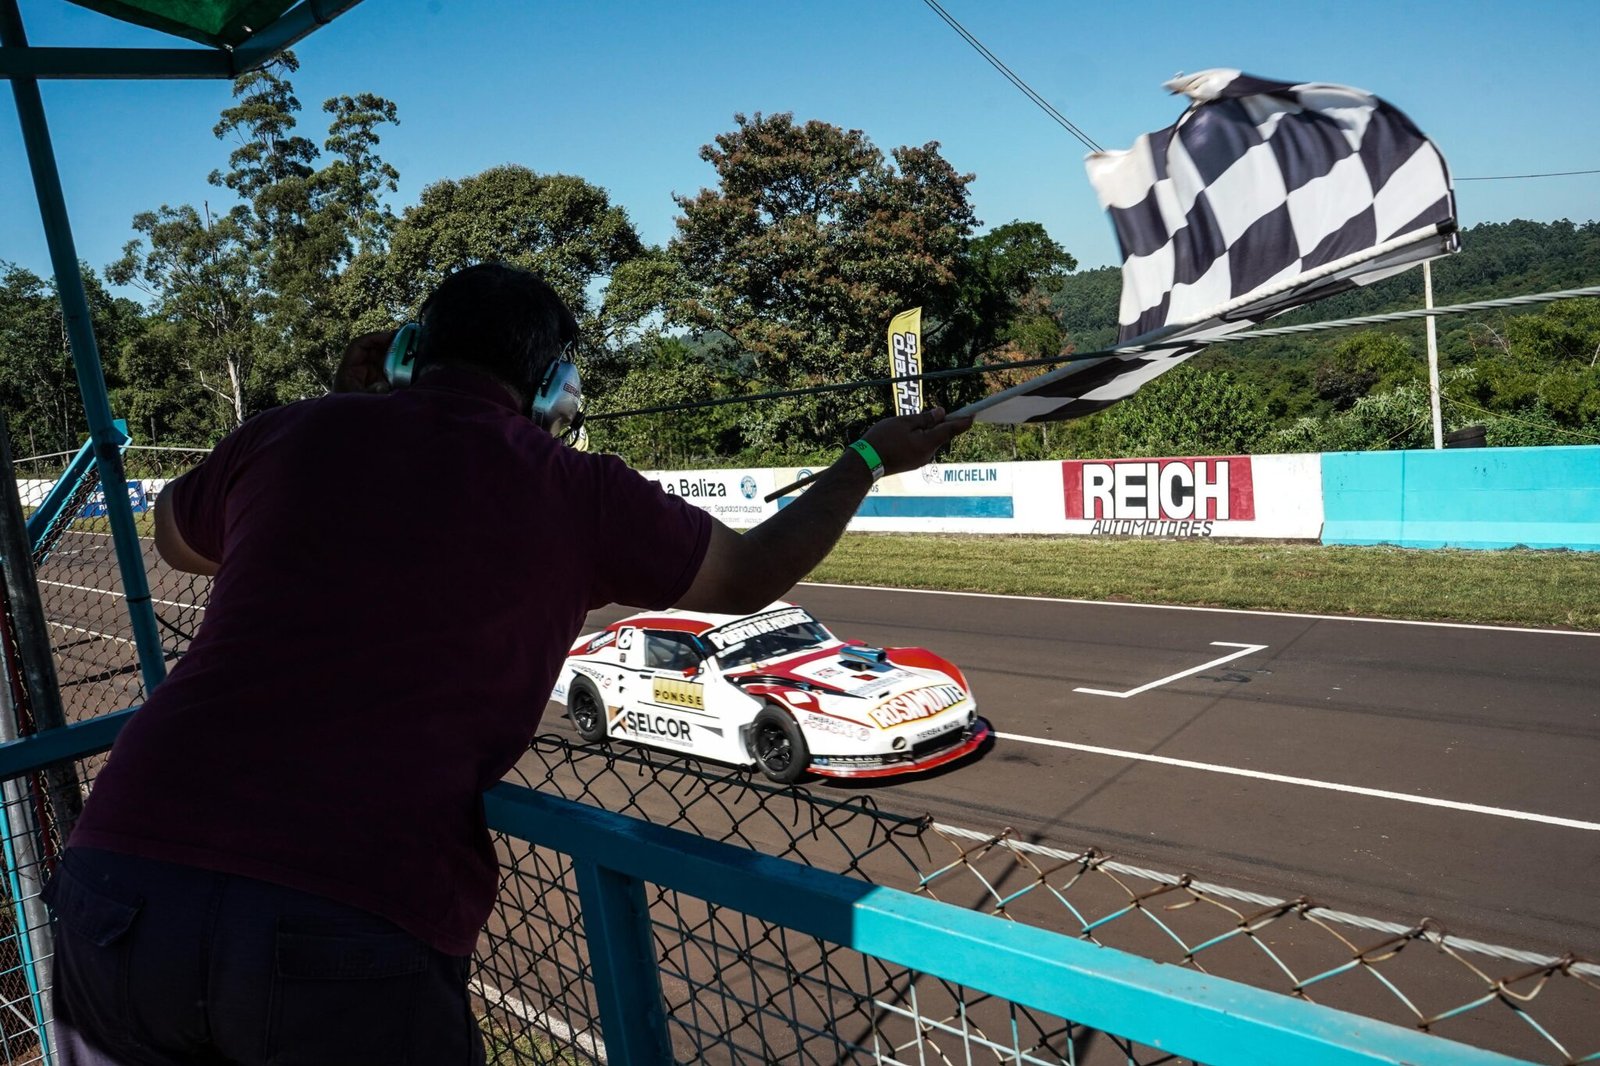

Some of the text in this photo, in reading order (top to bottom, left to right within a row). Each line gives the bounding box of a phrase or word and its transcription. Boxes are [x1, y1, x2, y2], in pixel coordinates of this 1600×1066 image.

[944, 469, 997, 482] MICHELIN
[679, 478, 727, 497] Baliza
[1082, 460, 1230, 520] REICH
[1090, 520, 1214, 537] AUTOMOTORES
[618, 629, 633, 649] 6
[655, 689, 703, 706] PONSSE
[873, 684, 967, 729] ROSAMONTE
[627, 710, 692, 741] SELCOR
